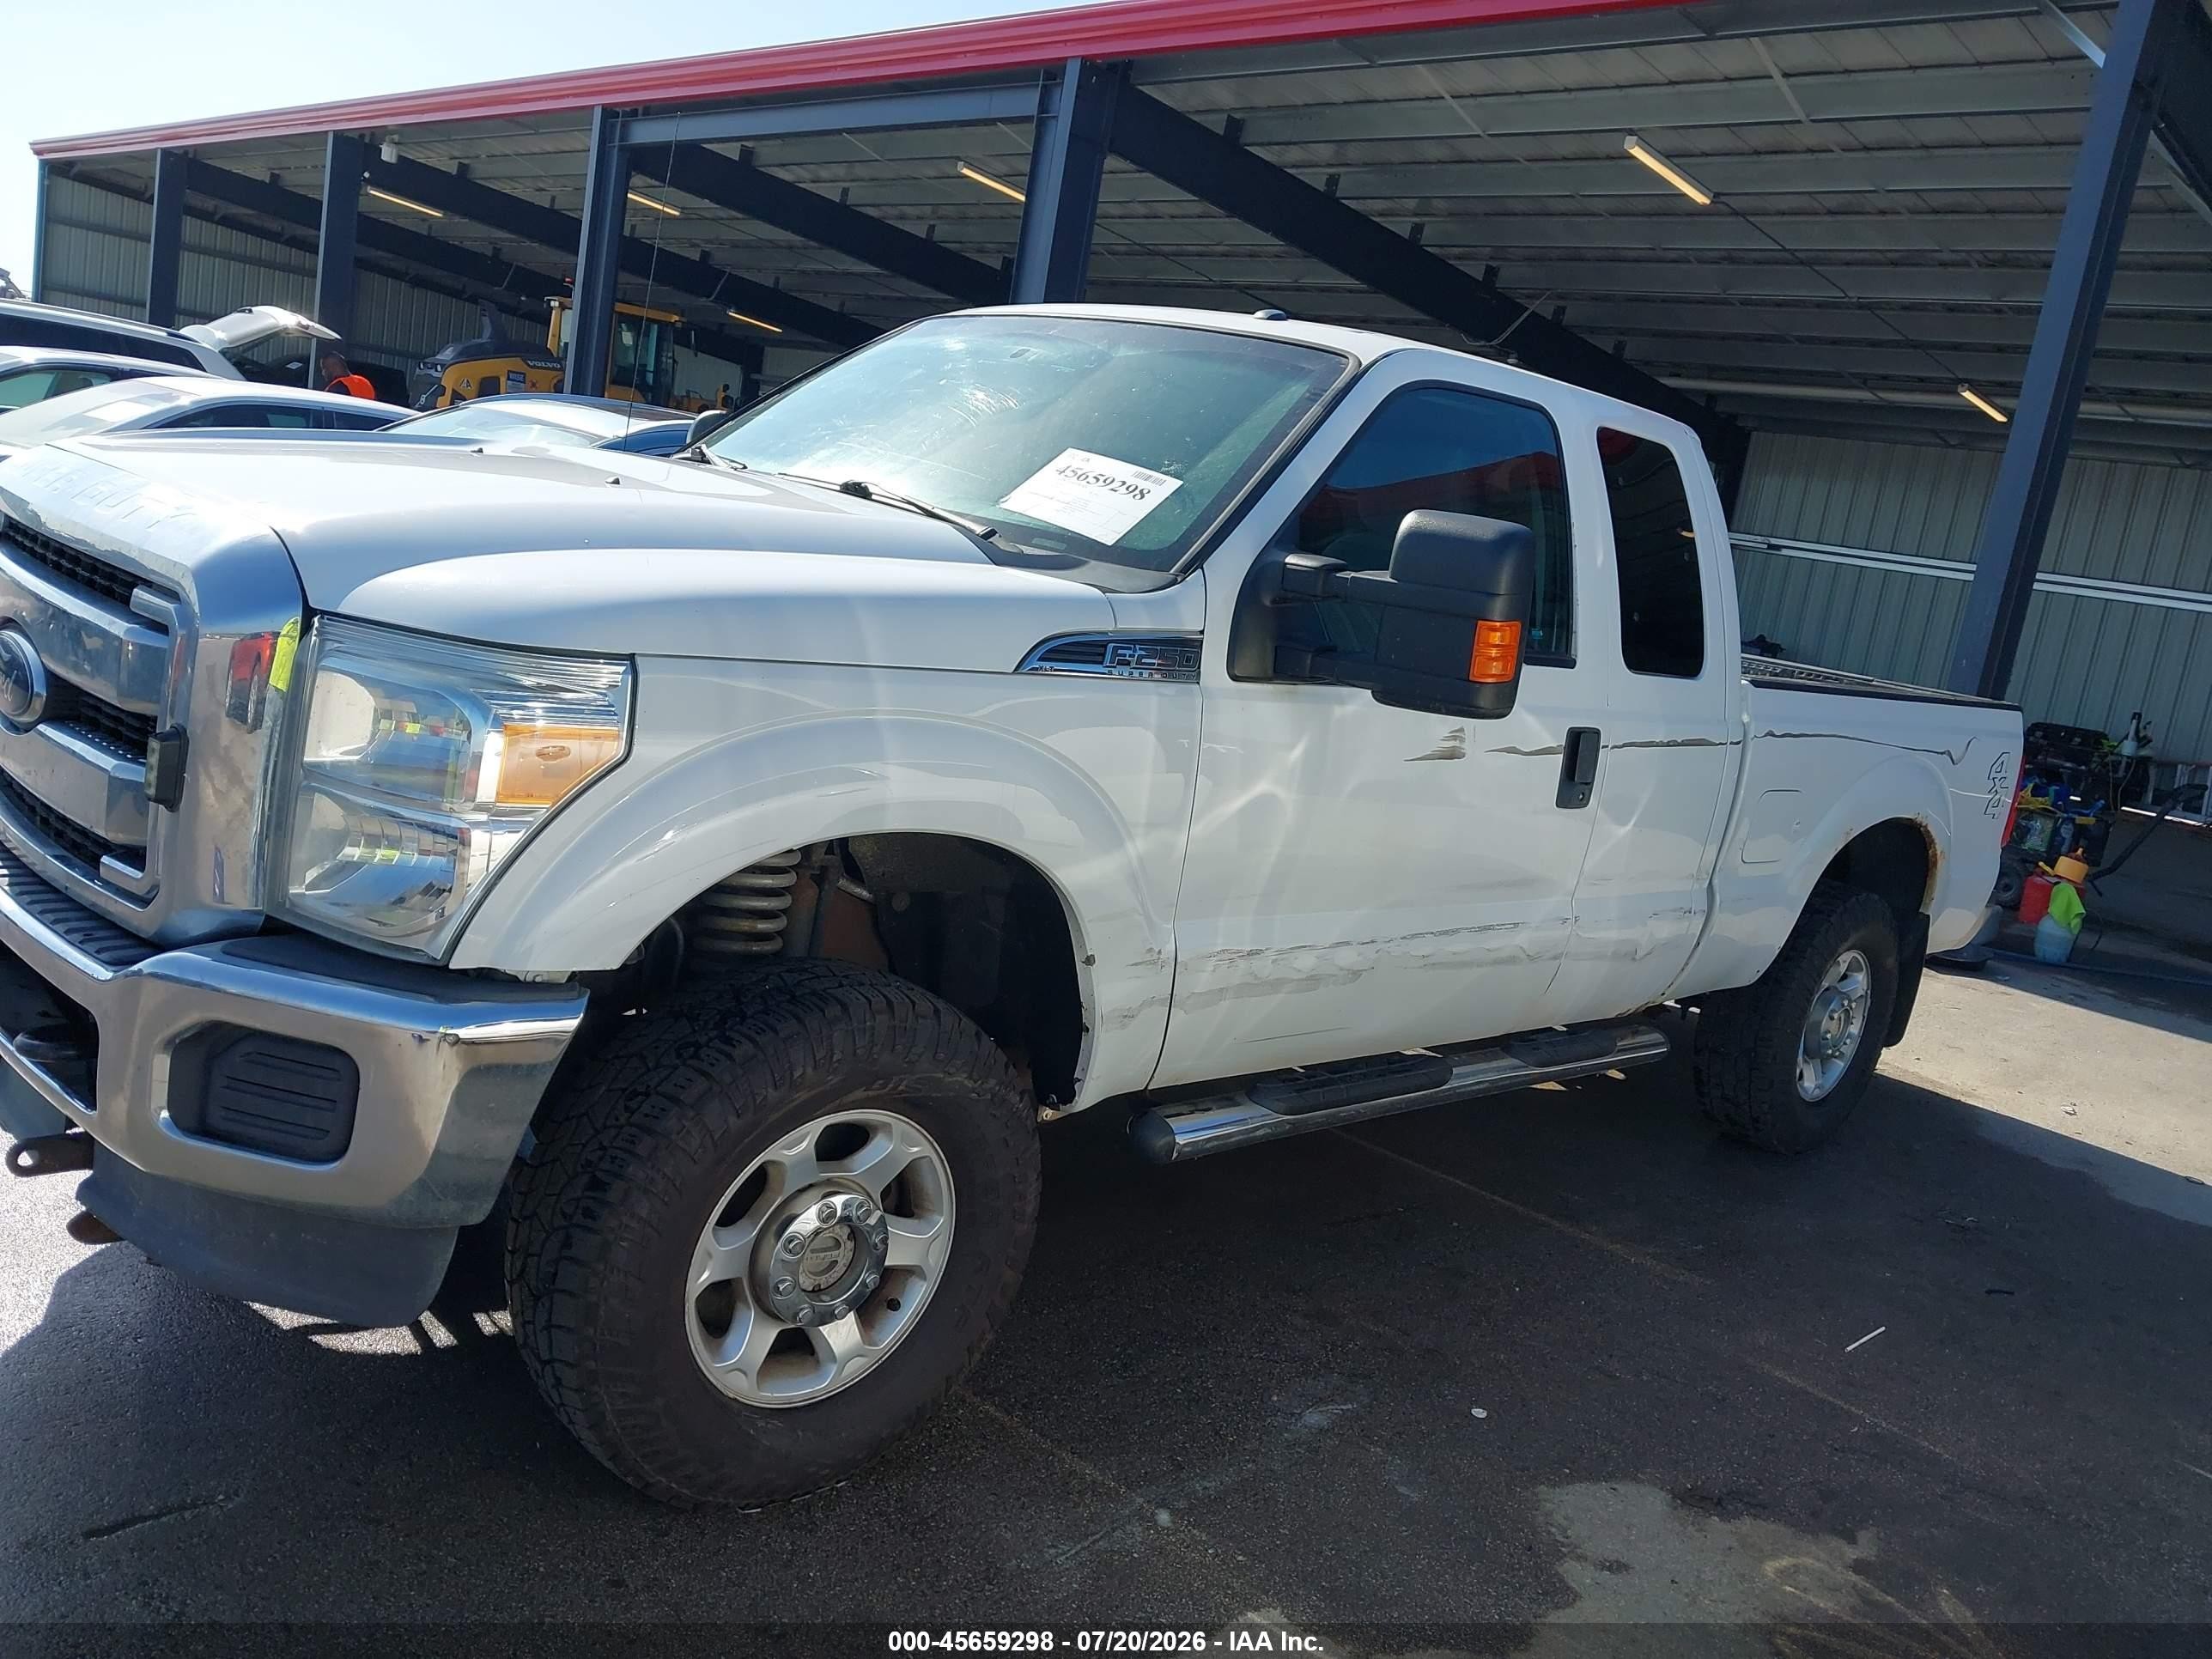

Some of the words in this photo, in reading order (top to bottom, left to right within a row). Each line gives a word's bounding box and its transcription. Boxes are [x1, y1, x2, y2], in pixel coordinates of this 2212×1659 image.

[527, 360, 561, 368] VOLVO
[1055, 465, 1152, 501] 45659298
[1103, 643, 1200, 671] F-250
[1107, 670, 1154, 679] SUPER
